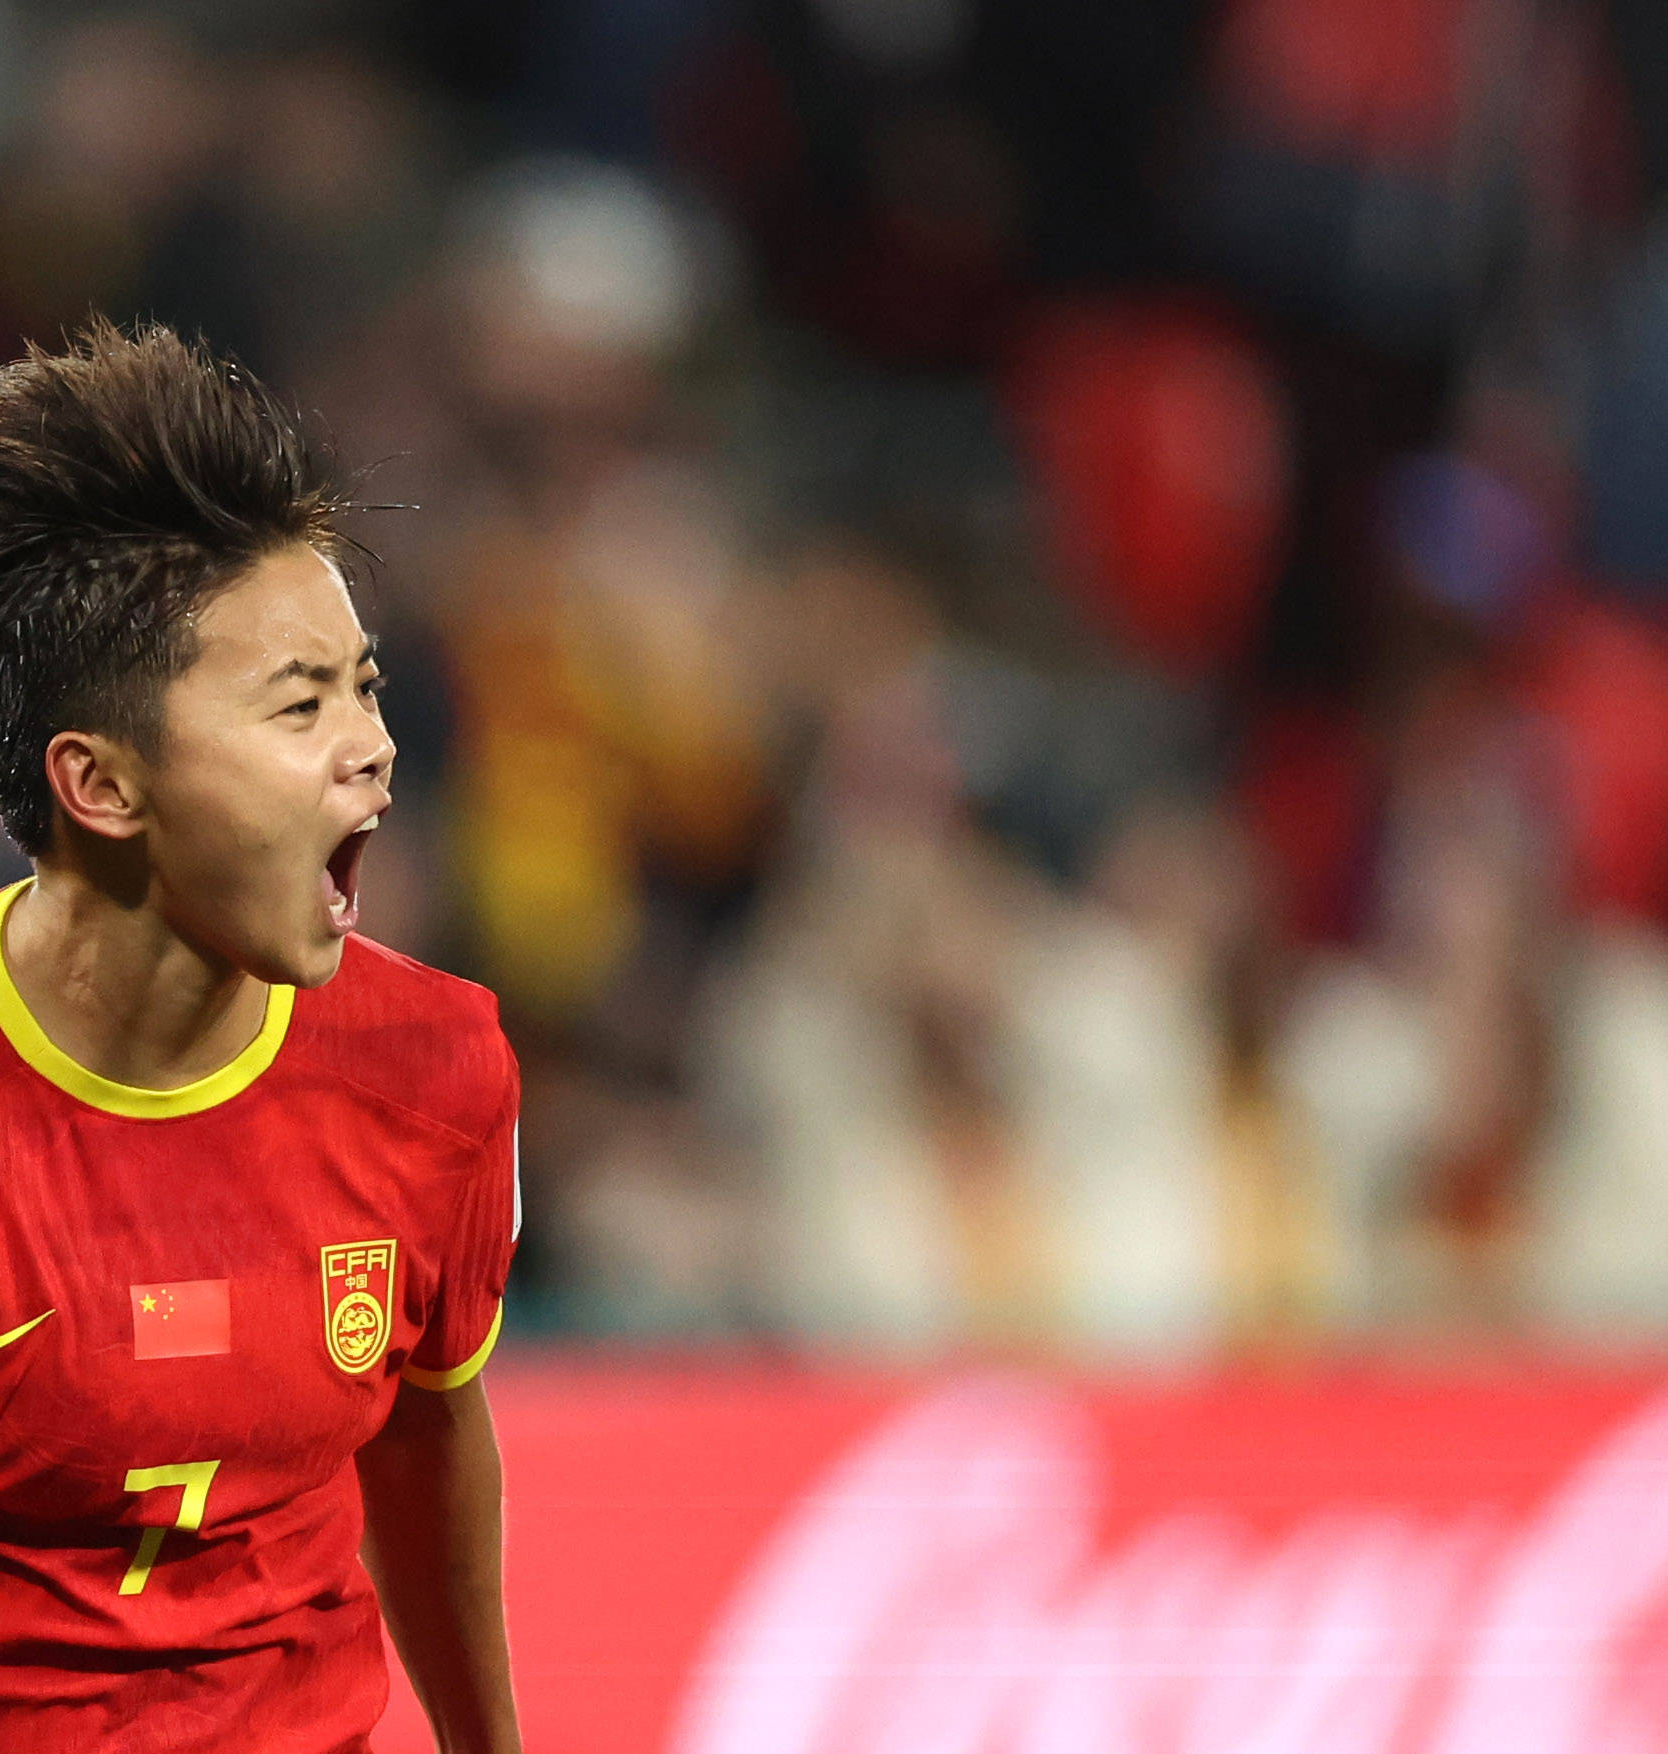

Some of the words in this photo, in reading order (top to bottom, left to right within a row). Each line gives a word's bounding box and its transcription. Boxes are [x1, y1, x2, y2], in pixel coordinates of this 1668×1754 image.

[328, 1248, 387, 1277] CFA
[345, 1273, 367, 1291] 中国
[118, 1460, 221, 1595] 7
